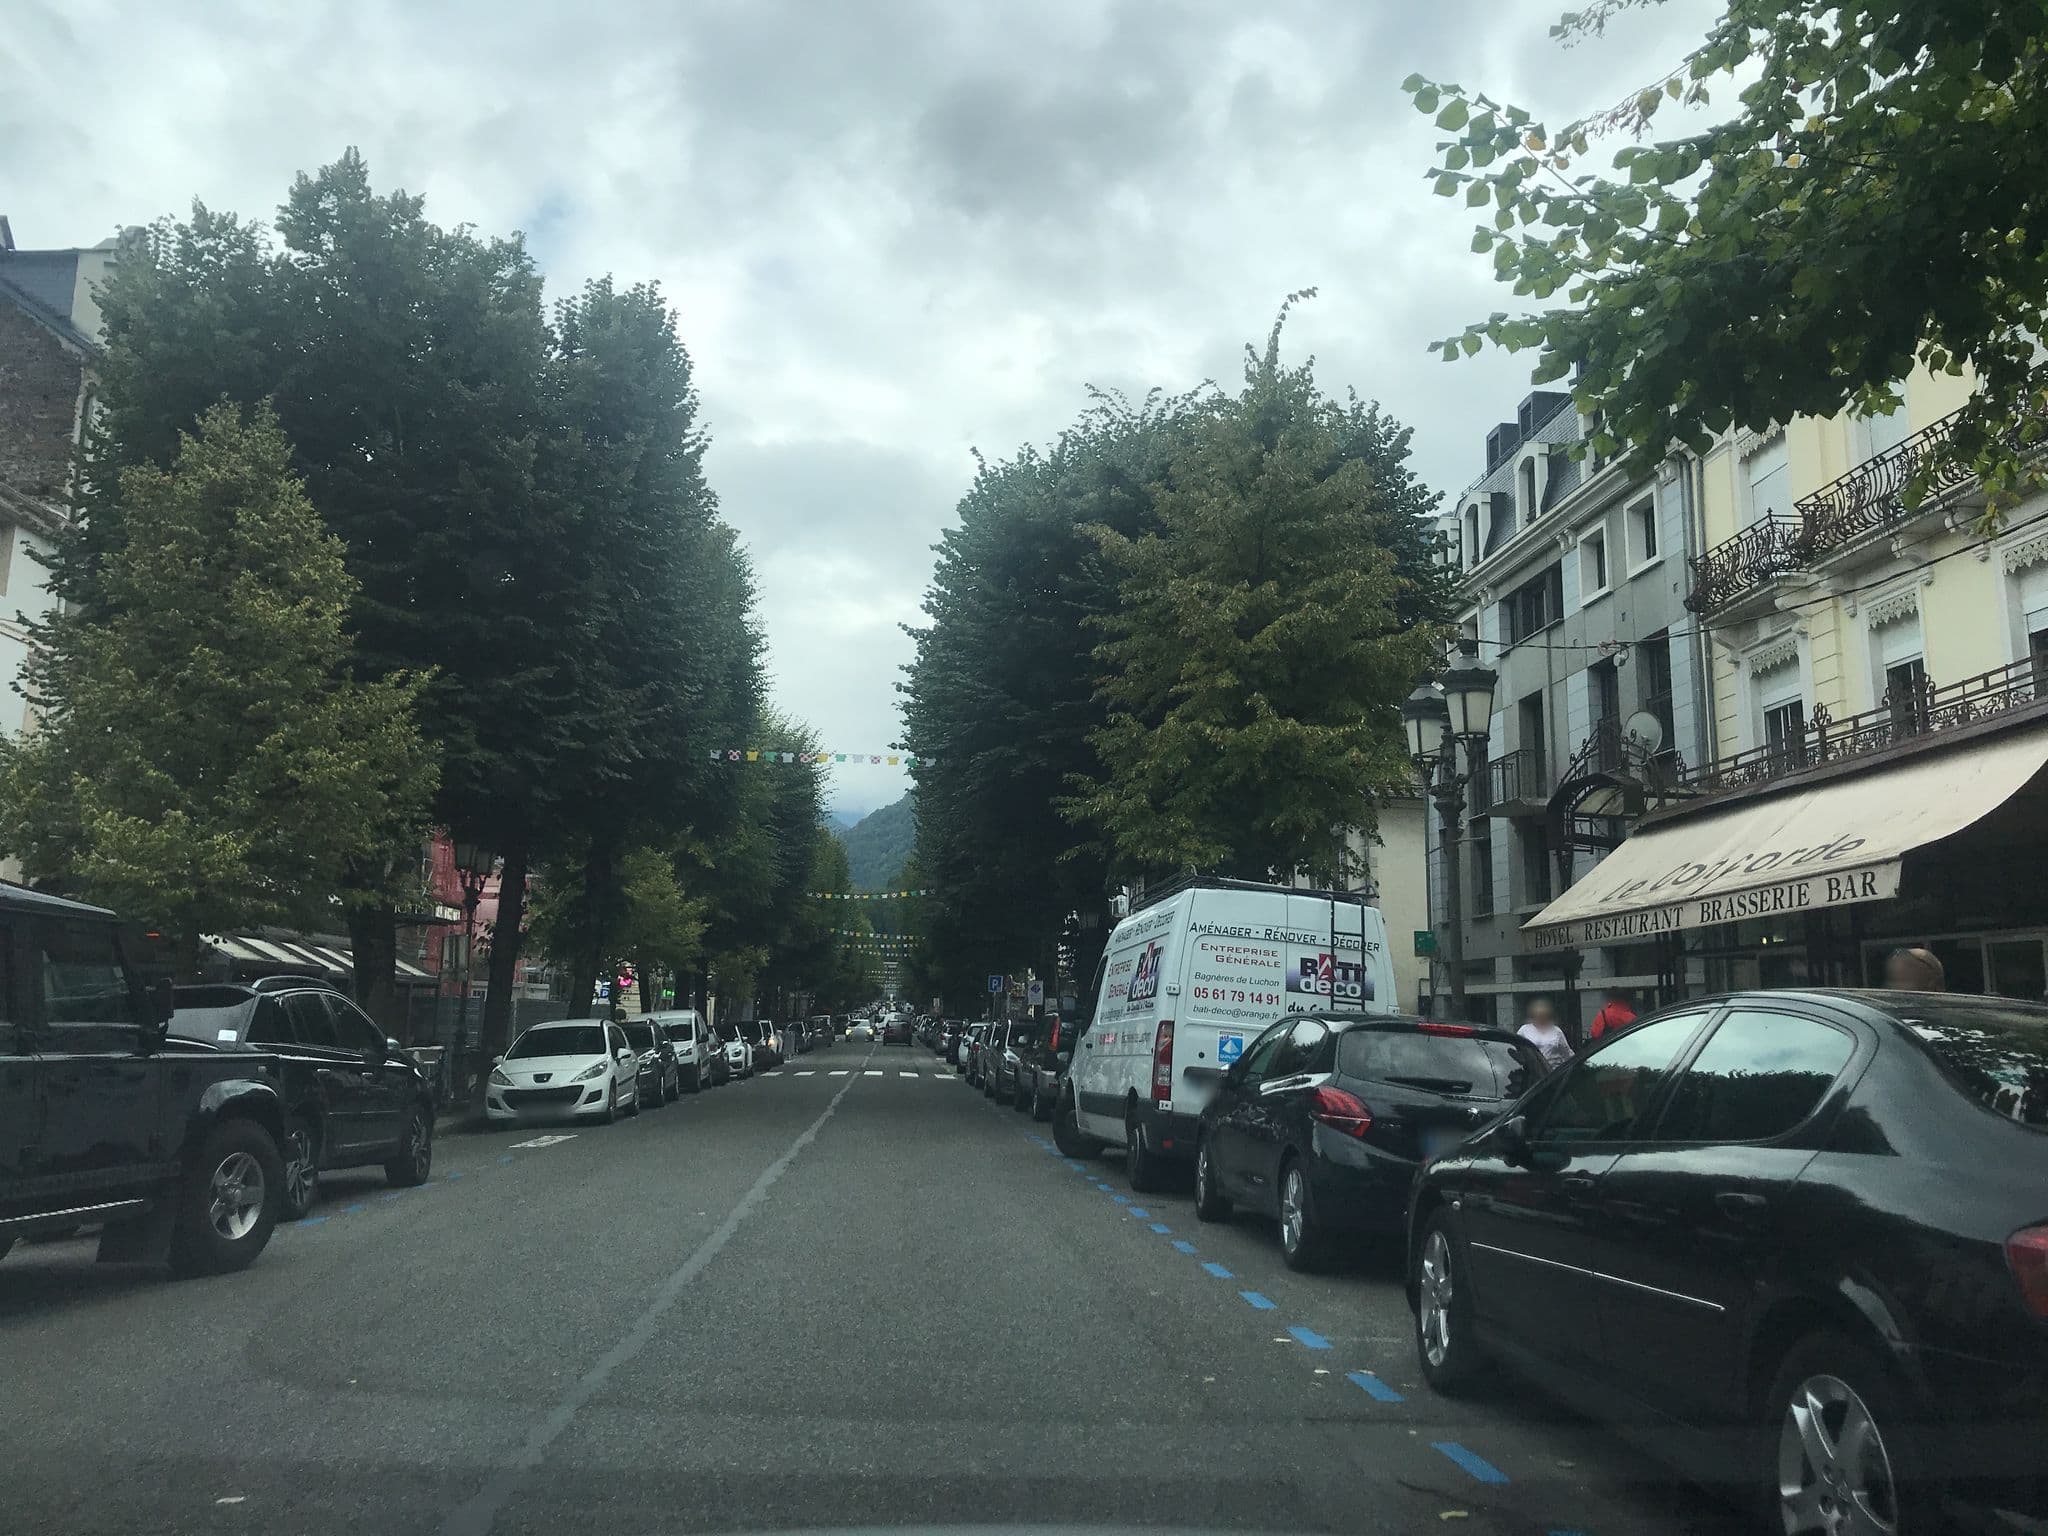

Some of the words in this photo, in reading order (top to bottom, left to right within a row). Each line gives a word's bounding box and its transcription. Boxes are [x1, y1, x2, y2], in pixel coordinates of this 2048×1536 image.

[1584, 907, 1684, 941] RESTAURANT
[1699, 883, 1810, 924] BRASSERIE
[1827, 871, 1878, 902] BAR
[1189, 921, 1251, 937] AMÉNAGER
[1264, 926, 1317, 944] RÉNOVER
[1201, 943, 1279, 958] ENTREPRISE
[1194, 971, 1234, 984] Bagnères
[1236, 975, 1247, 984] de
[1249, 977, 1280, 987] Luchon
[1194, 987, 1209, 998] 05
[1212, 989, 1225, 1000] 61
[1231, 991, 1245, 1002] 79
[1249, 992, 1263, 1004] 14
[1266, 994, 1280, 1006] 91
